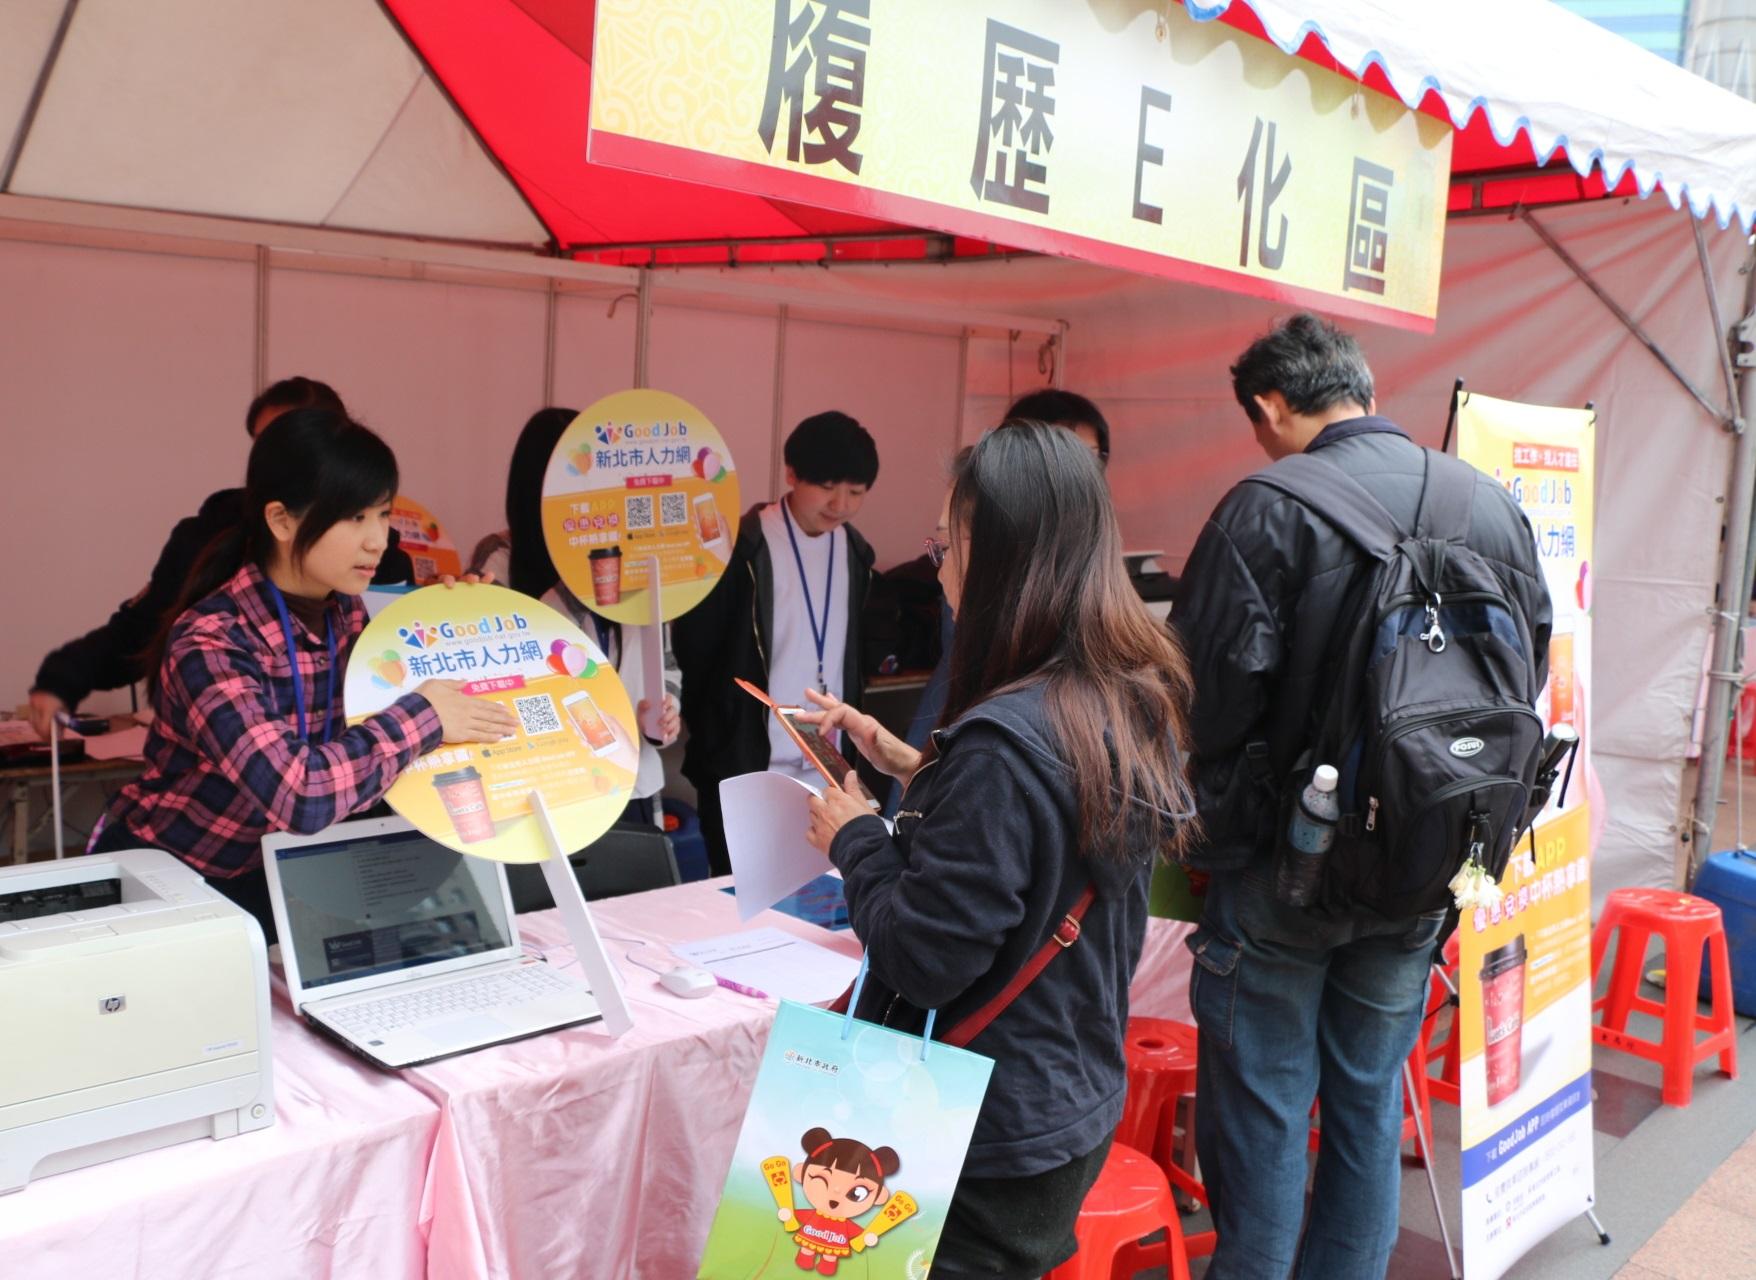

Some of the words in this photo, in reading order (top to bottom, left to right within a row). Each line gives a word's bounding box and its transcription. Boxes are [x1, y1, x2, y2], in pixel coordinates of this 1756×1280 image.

[624, 422, 660, 438] Good
[664, 420, 687, 437] Job
[595, 445, 691, 469] 新北市人力網
[1551, 479, 1572, 505] Job
[440, 617, 491, 638] Good
[495, 614, 528, 633] Job
[408, 639, 544, 677] 新北市人力網
